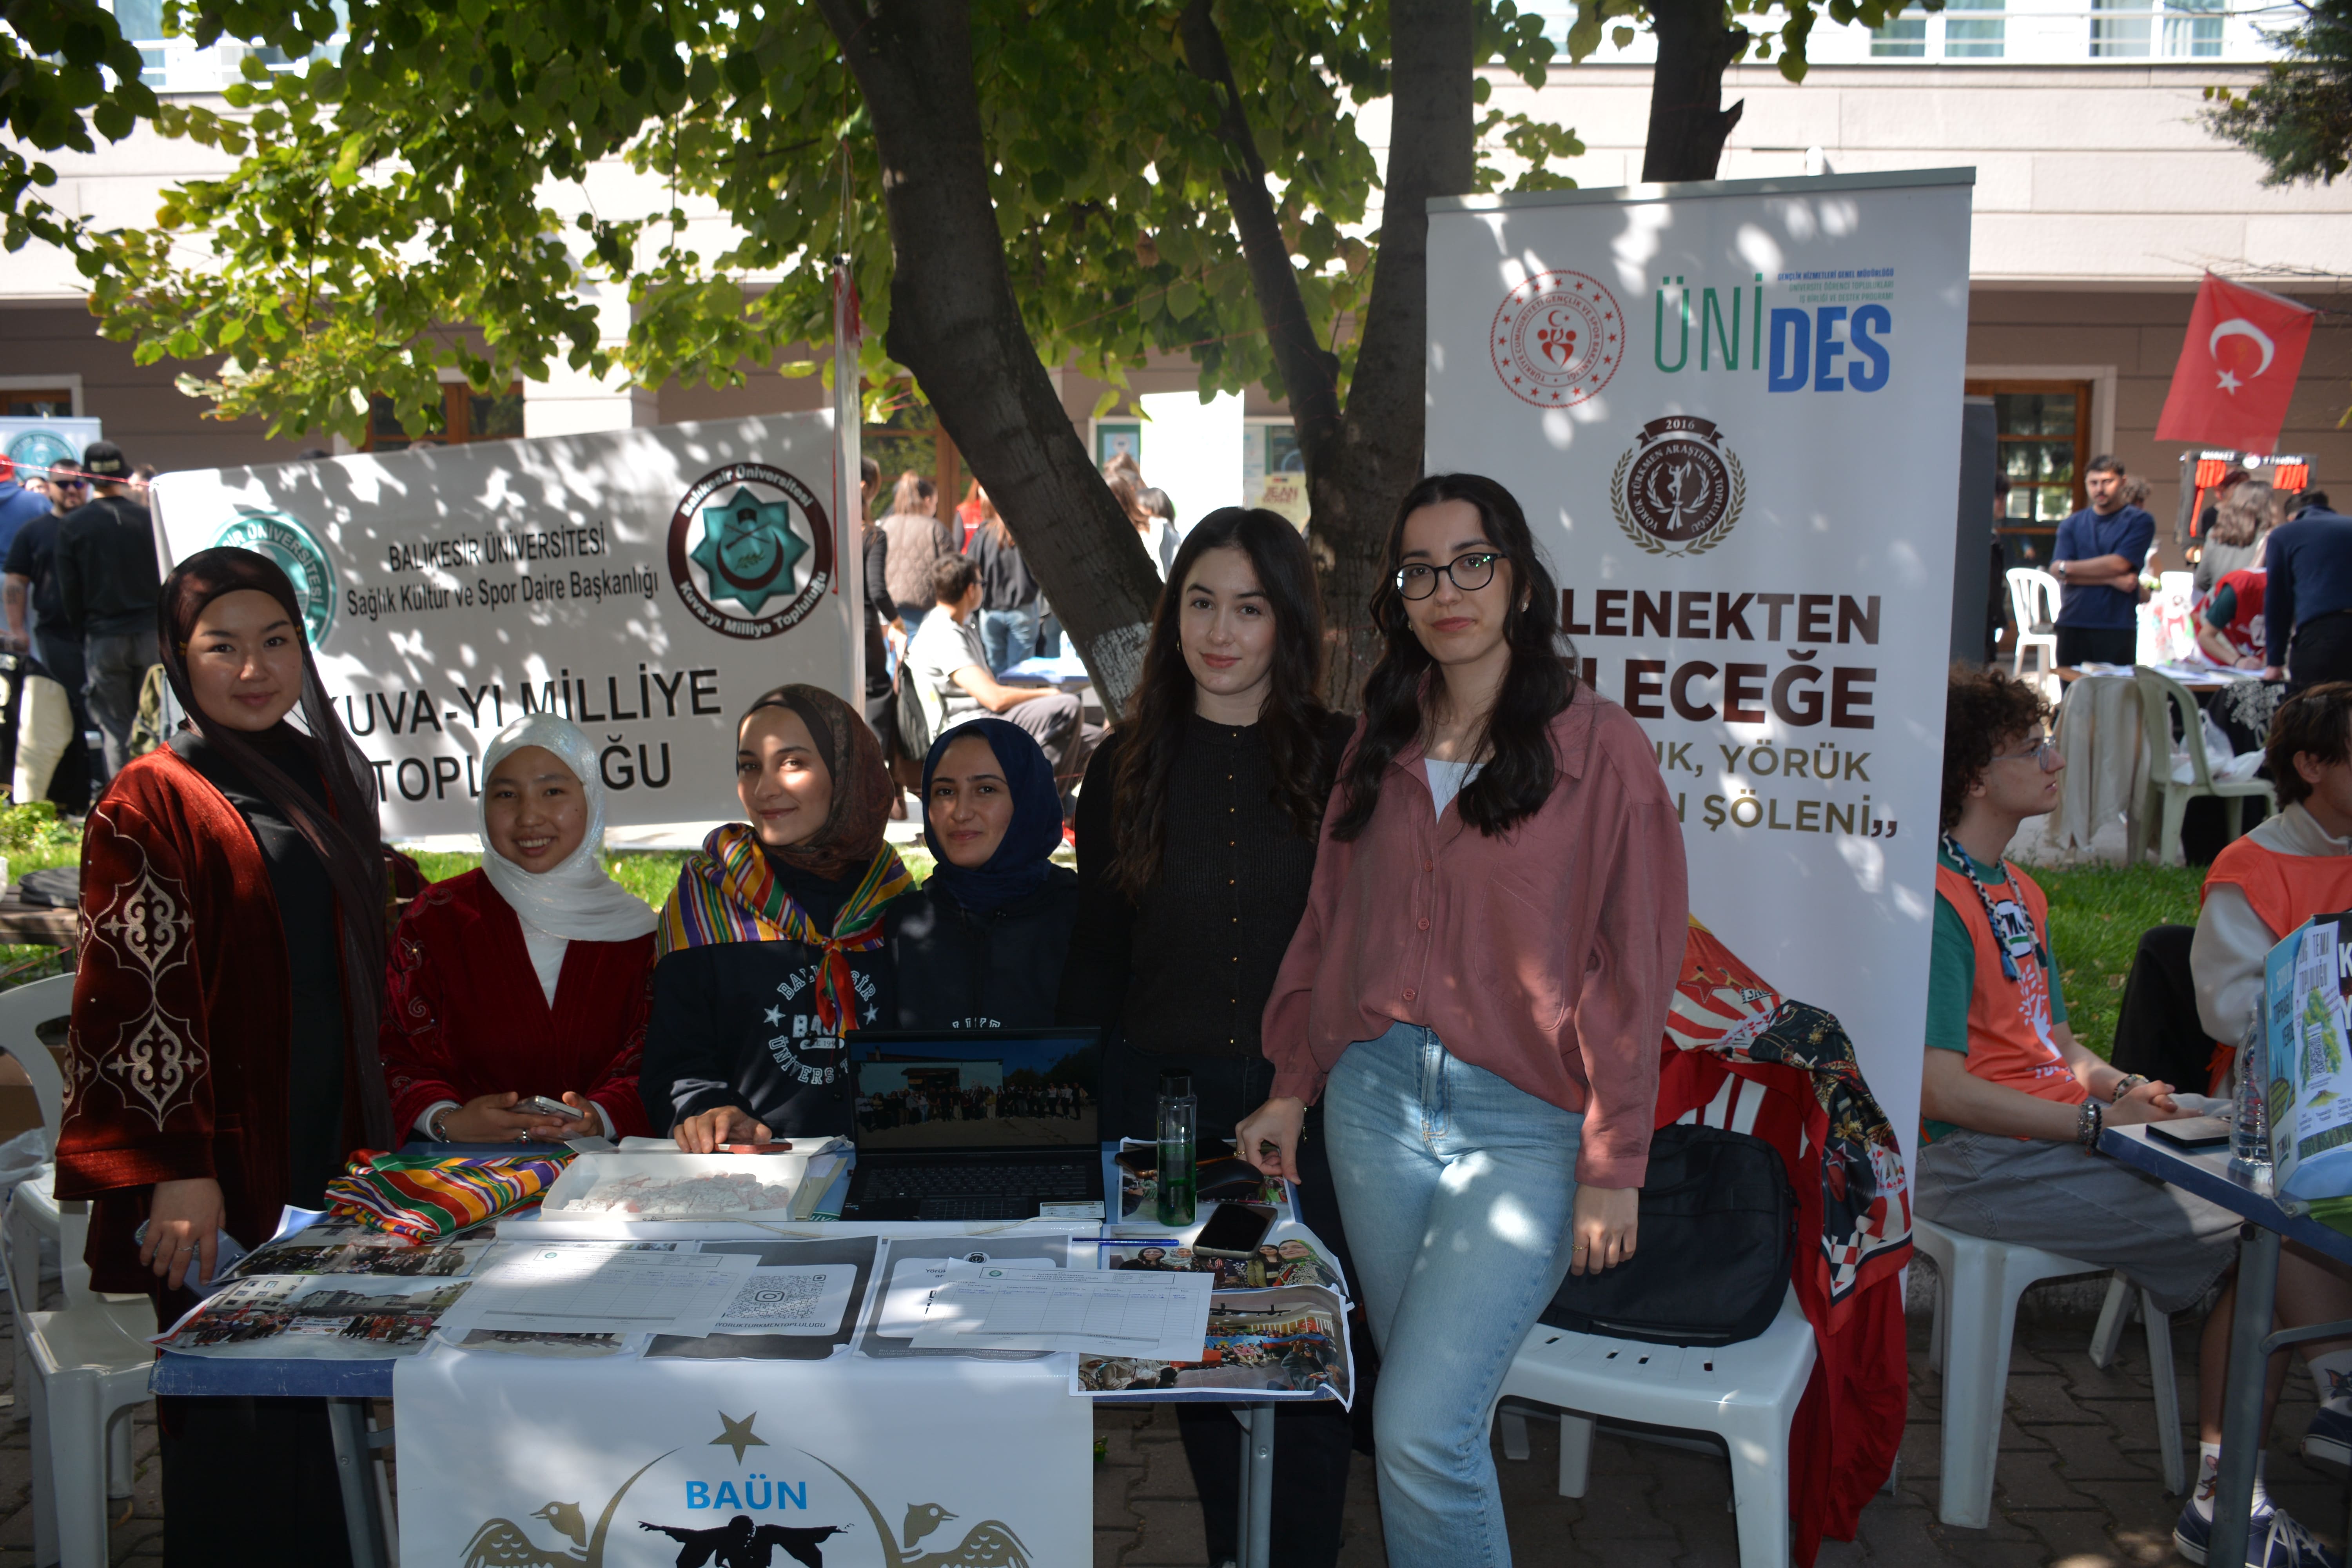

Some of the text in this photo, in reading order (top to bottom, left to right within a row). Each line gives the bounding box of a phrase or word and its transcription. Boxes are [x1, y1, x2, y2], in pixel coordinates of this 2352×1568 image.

[1665, 419, 1695, 430] 2016
[1631, 448, 1664, 497] TÜRKMEN
[388, 521, 606, 572] BALIKESİR ÜNİVERSİTESİ
[347, 565, 659, 621] Sağlık Kültür ve Spor Daire Başkanlığı
[724, 618, 772, 638] Milliye
[773, 571, 827, 630] Topluluğu
[1562, 588, 1881, 645] LENEKTEN
[330, 663, 722, 737] UVA-YI MİLLİYE
[1719, 739, 1872, 782] YÖRÜK
[685, 1474, 808, 1511] BAÜN
